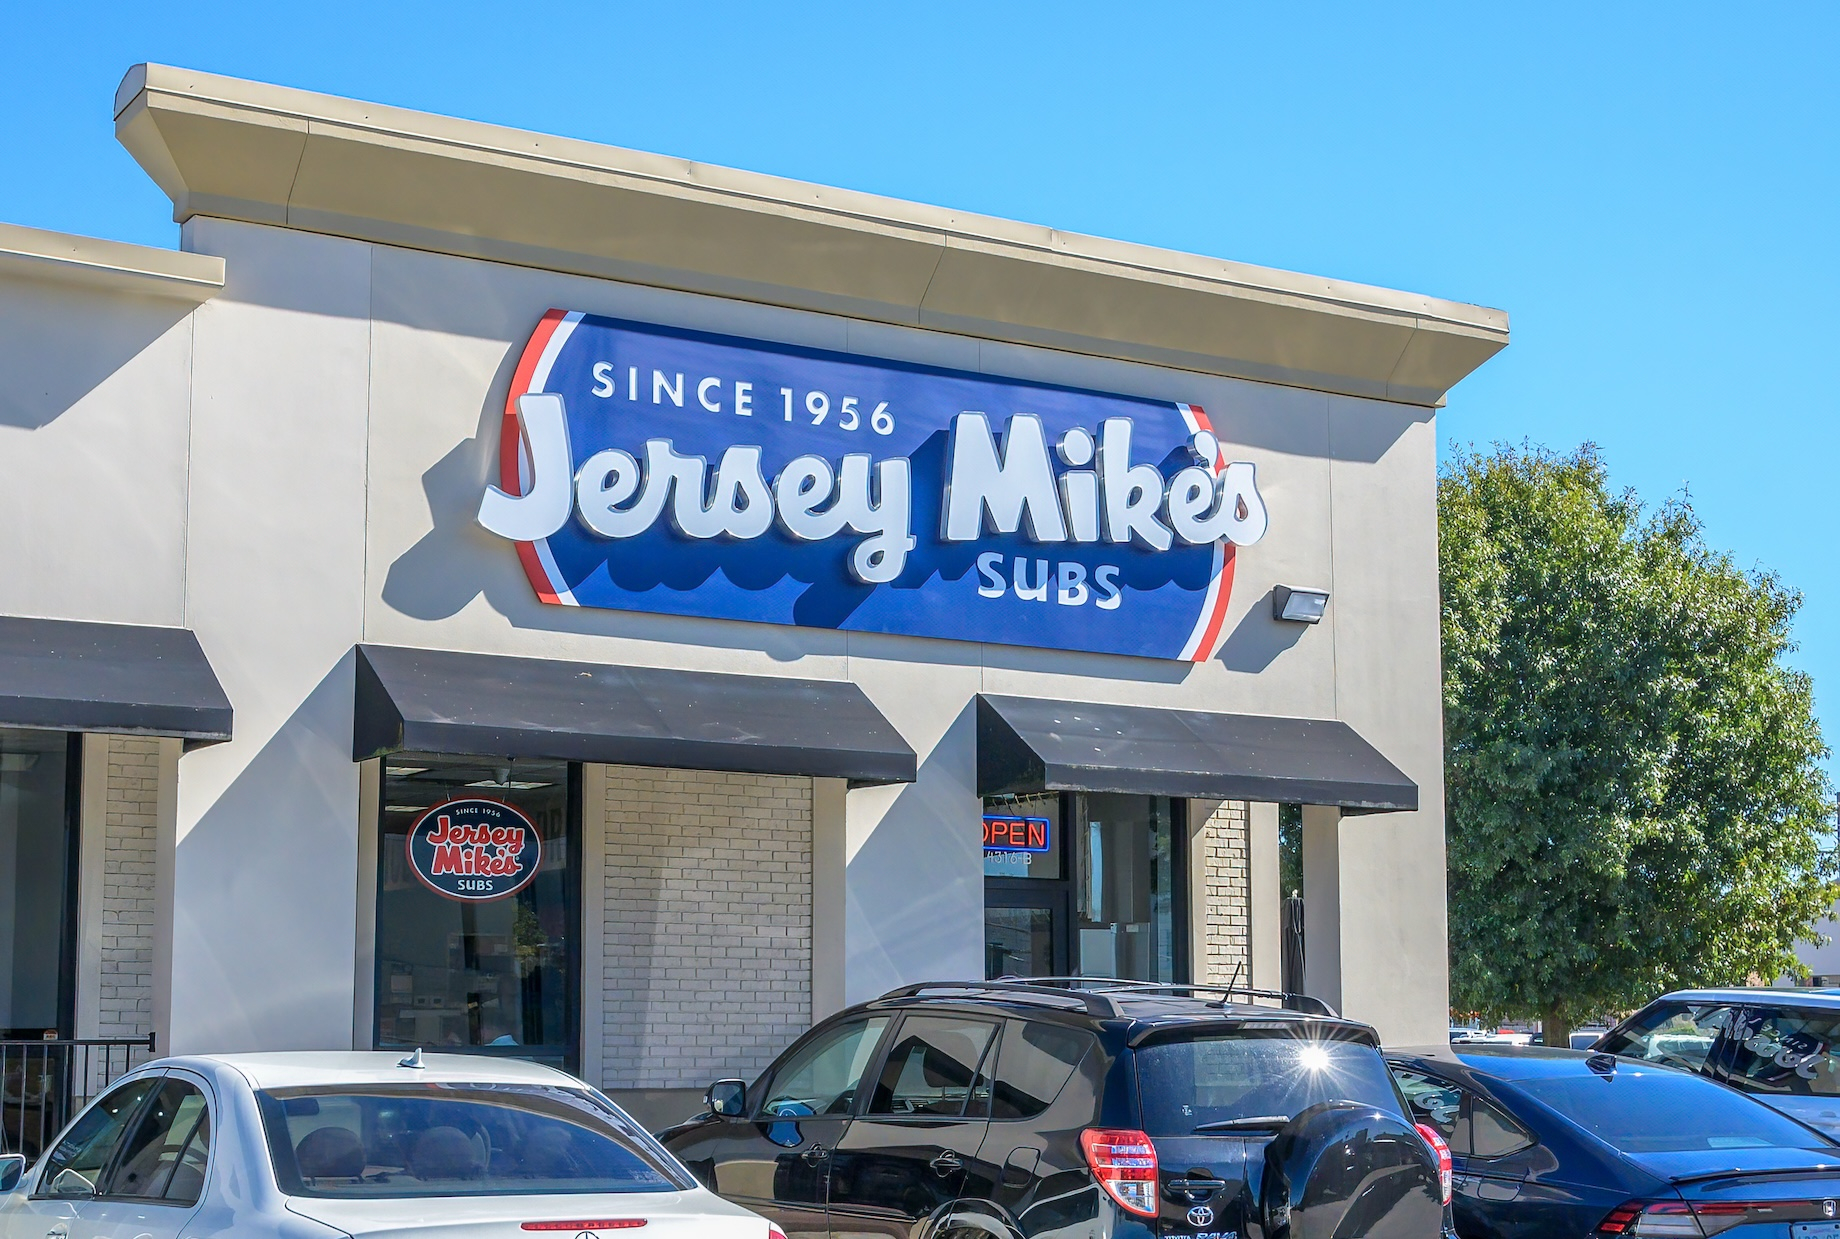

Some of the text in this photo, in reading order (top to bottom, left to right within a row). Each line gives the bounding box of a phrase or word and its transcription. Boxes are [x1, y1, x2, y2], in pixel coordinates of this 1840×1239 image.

[591, 361, 896, 436] SINCE 1956
[476, 392, 1268, 584] Jersey Mike's
[976, 551, 1123, 610] SUBS
[456, 808, 501, 818] SINCE 1956
[426, 815, 525, 855] Jersey
[431, 844, 523, 876] Mike's
[987, 851, 1032, 864] 4316-B
[457, 880, 493, 890] SUBS
